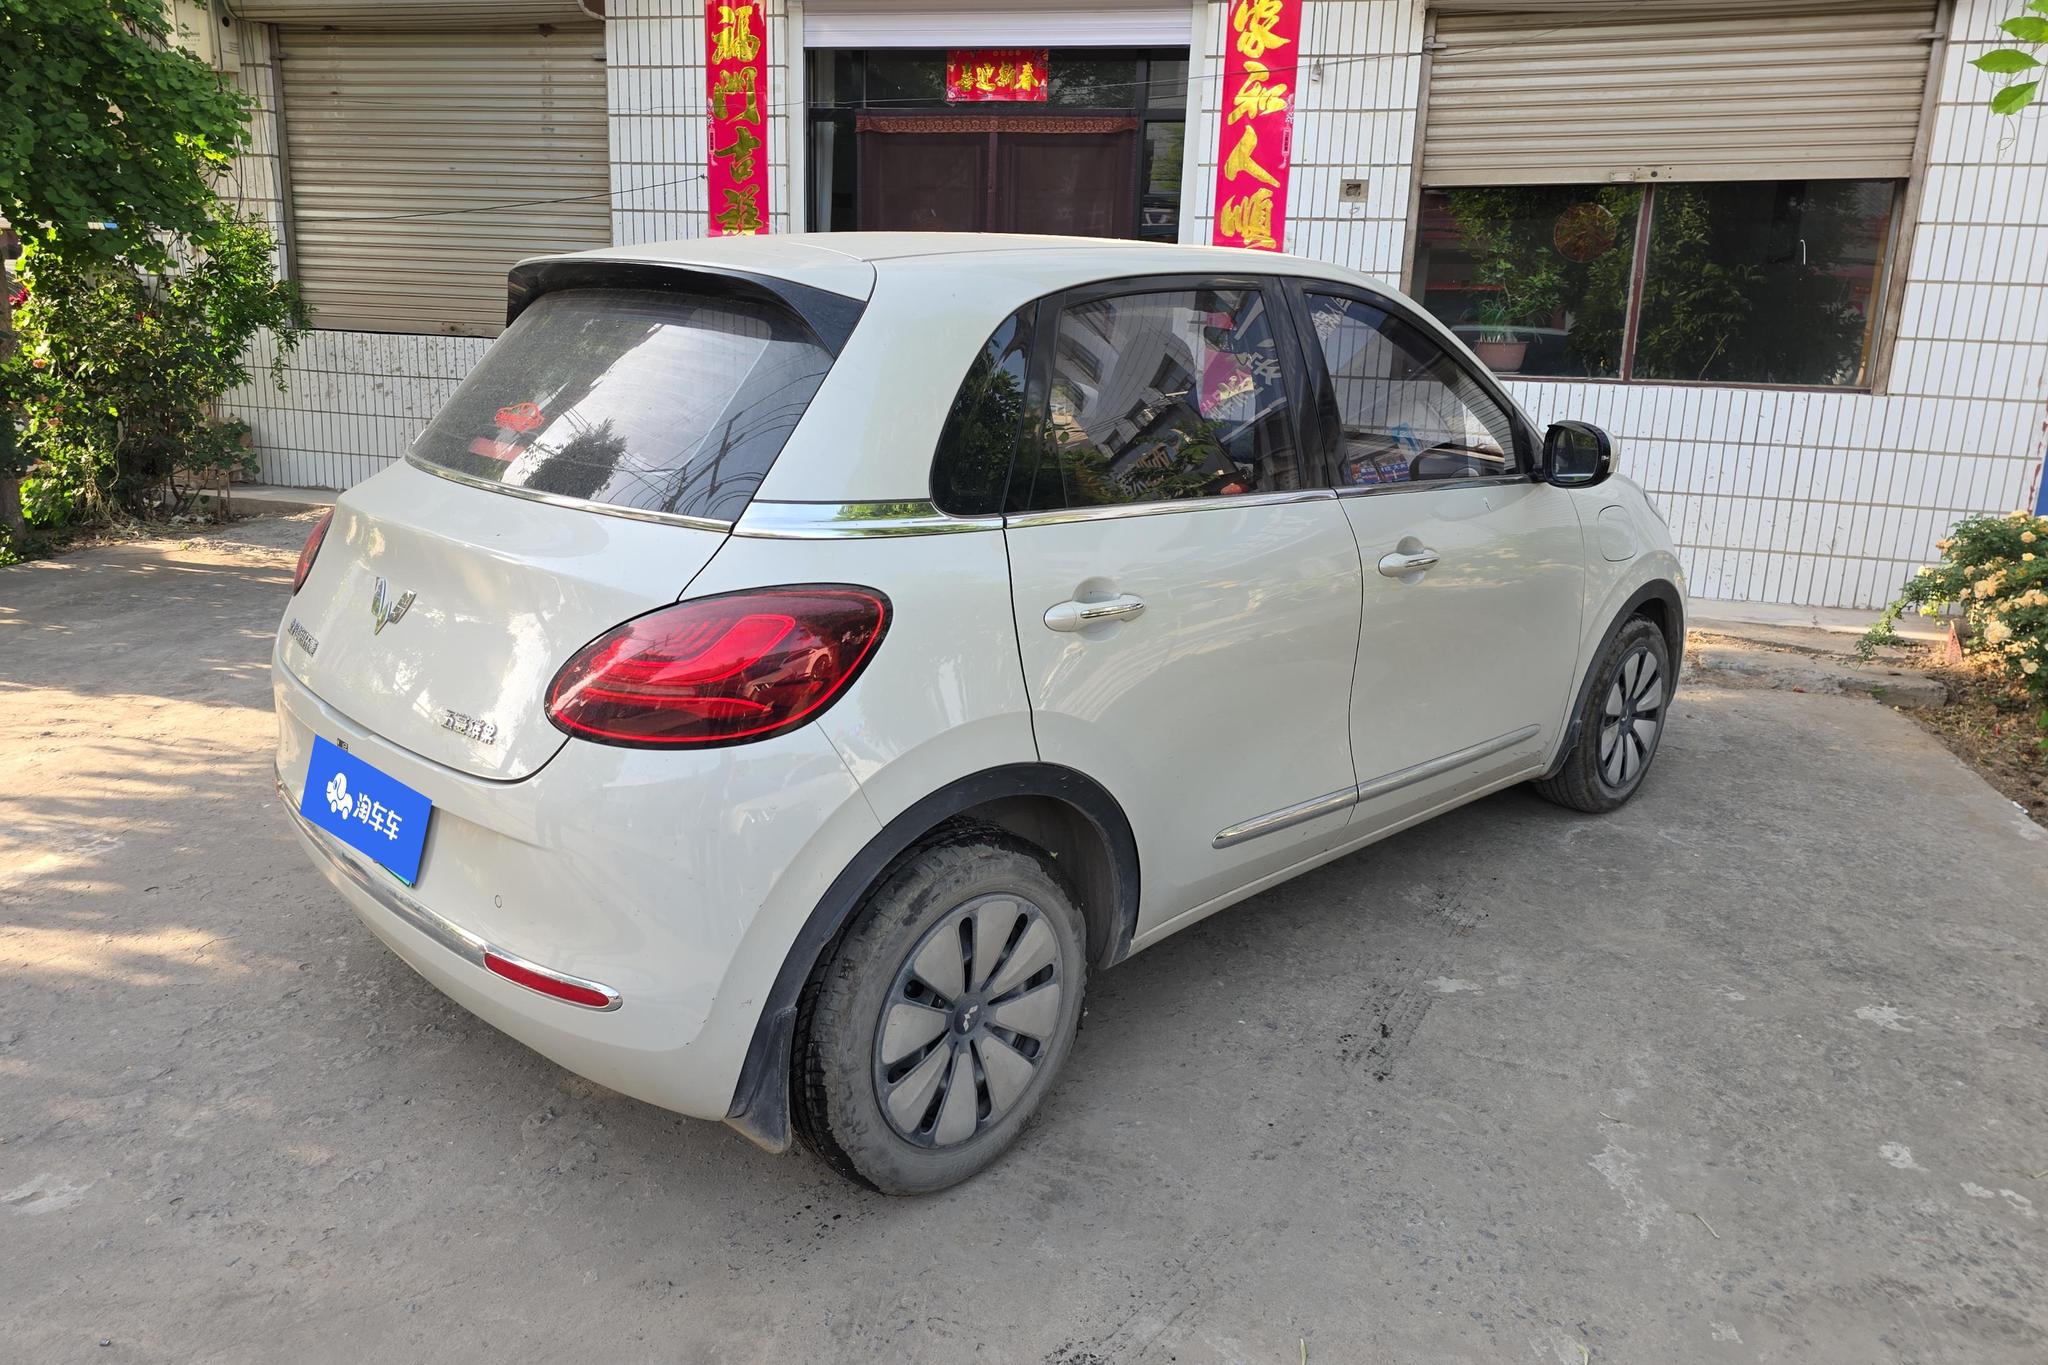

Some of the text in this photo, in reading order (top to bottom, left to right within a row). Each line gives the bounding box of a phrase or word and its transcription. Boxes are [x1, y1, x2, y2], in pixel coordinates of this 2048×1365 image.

[955, 61, 1038, 92] 喜迎新春
[441, 709, 498, 746] 五菱缤果
